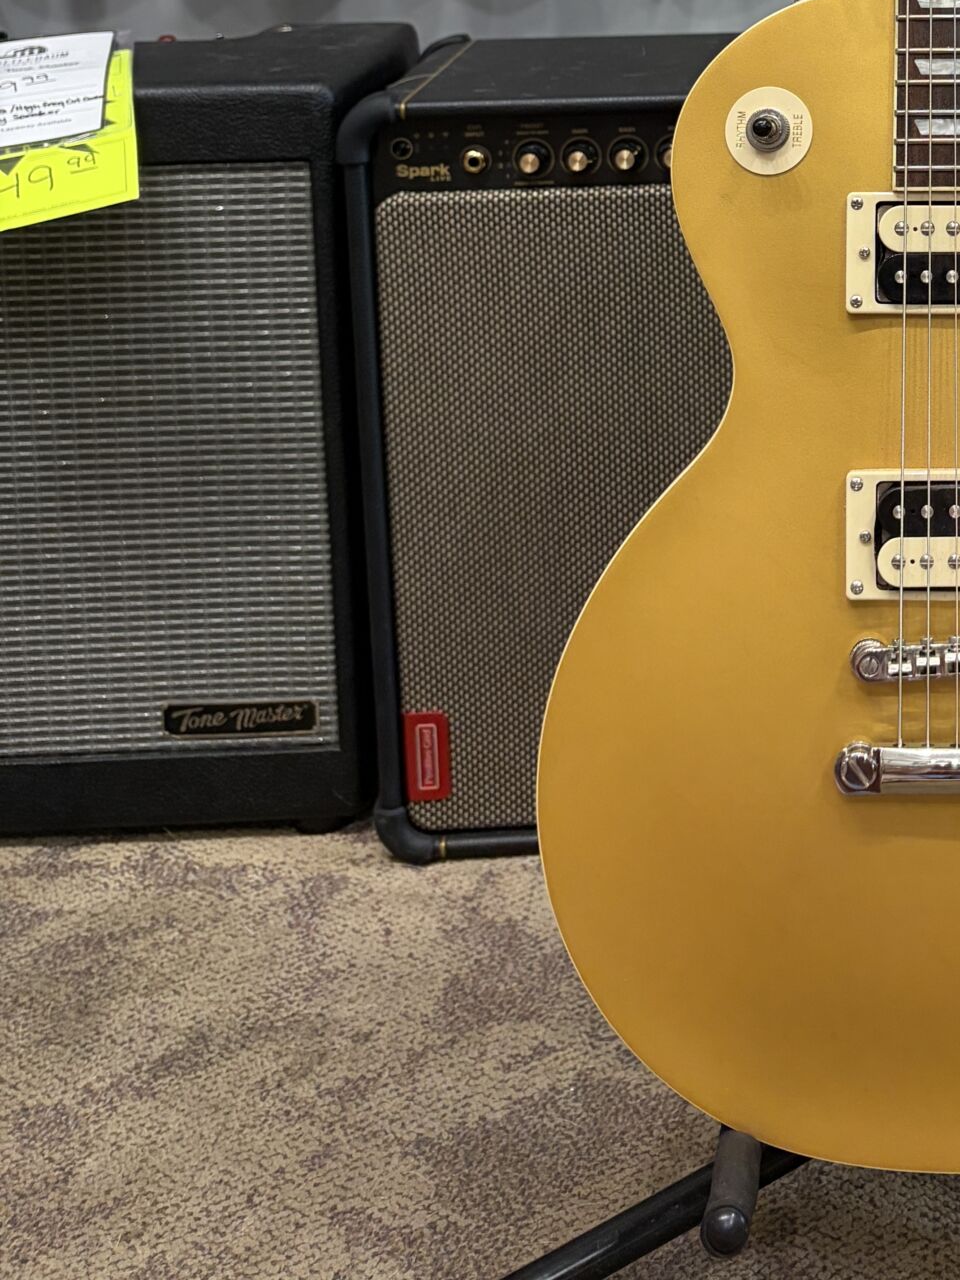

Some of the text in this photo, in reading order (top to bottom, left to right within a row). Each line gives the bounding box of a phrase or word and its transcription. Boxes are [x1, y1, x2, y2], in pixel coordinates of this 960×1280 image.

[736, 111, 746, 148] RHYTHM
[792, 114, 803, 148] TREBLE
[395, 163, 450, 179] Spark
[171, 704, 308, 732] Tone Master
